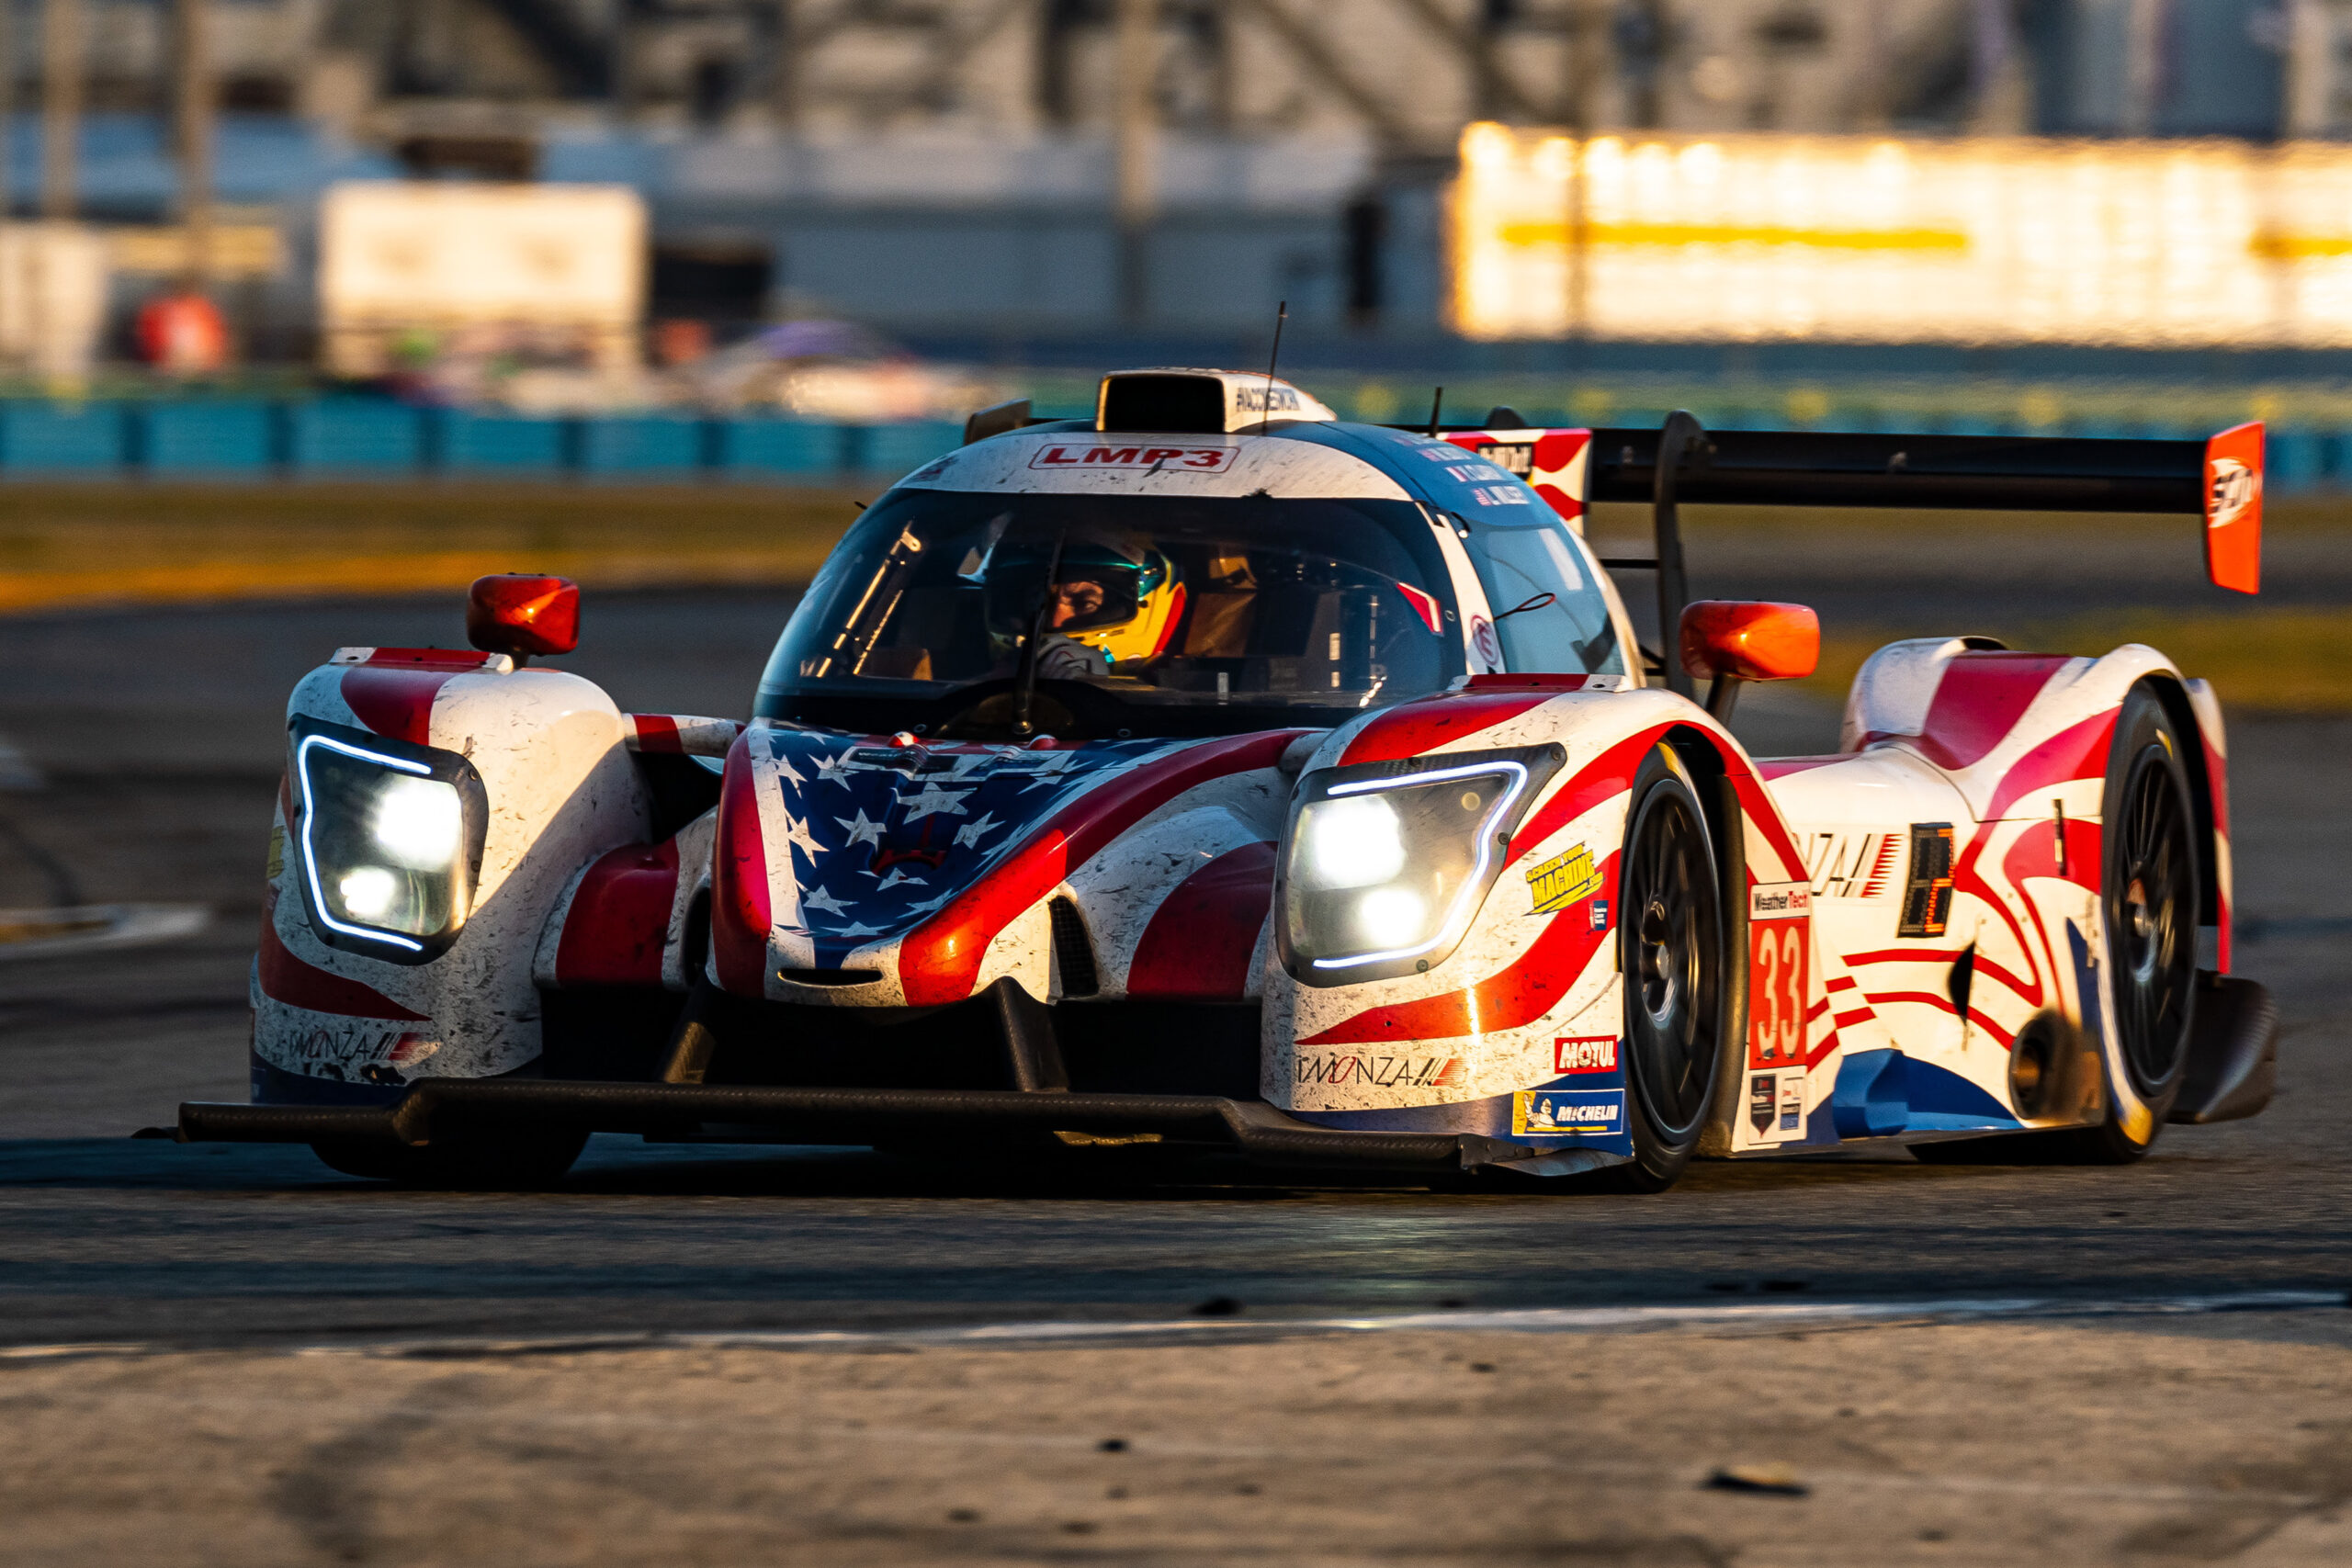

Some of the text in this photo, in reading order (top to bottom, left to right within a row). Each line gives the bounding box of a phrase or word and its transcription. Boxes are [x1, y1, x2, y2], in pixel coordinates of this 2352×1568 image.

[1043, 447, 1224, 467] LMP3
[1531, 849, 1596, 909] MACHINE
[1757, 925, 1802, 1060] 33
[1558, 1040, 1615, 1069] MOTUL
[1556, 1105, 1619, 1122] MICHELIN
